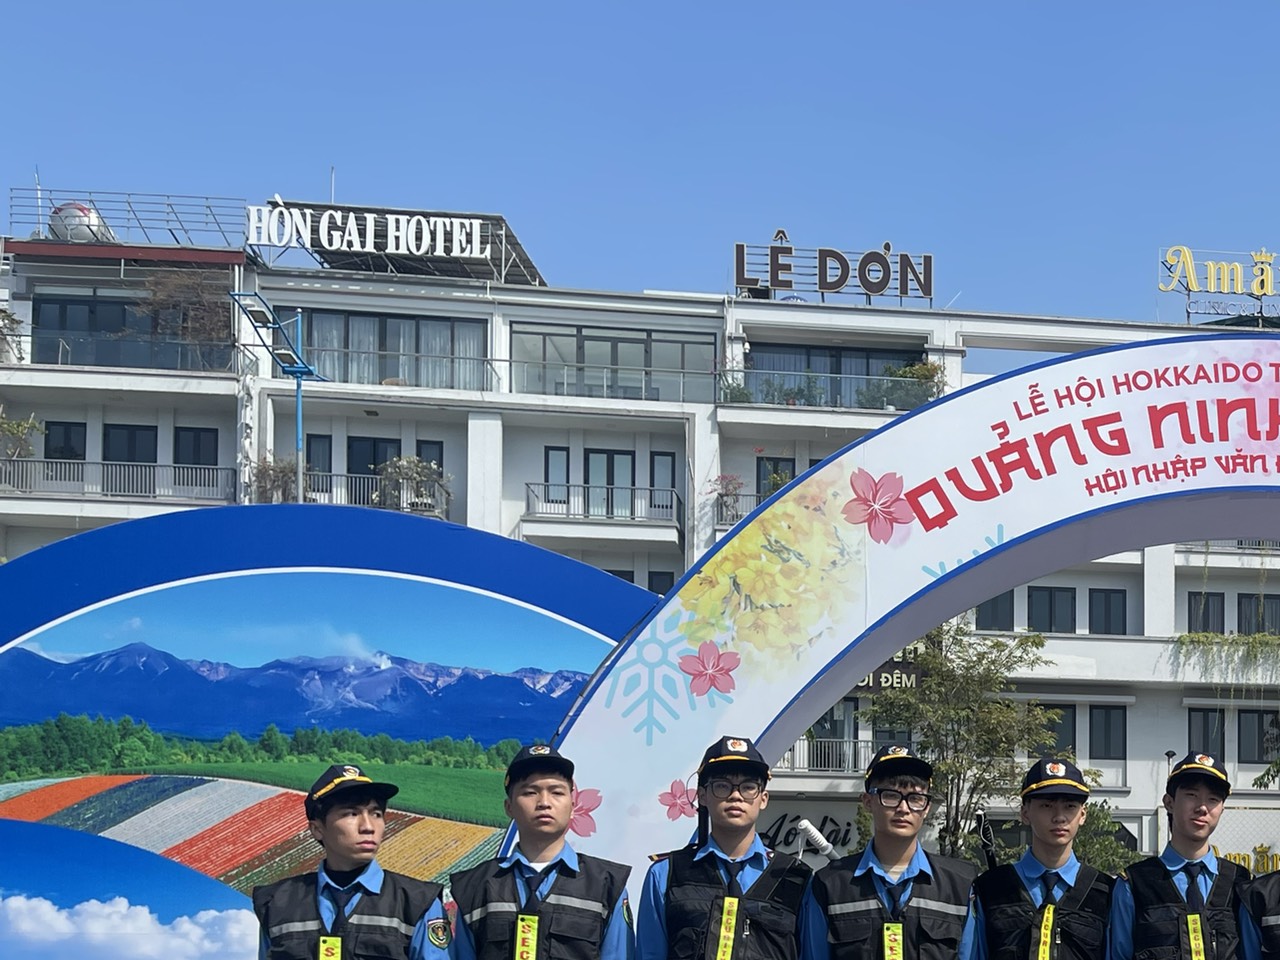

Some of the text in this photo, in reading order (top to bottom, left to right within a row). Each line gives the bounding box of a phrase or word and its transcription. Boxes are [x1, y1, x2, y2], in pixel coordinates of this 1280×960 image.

[247, 193, 492, 259] HÒN GAI HOTEL
[734, 229, 794, 289] LÊ
[1013, 382, 1050, 422] LỄ
[1054, 376, 1105, 409] HỘI
[1113, 362, 1263, 395] HOKKAIDO
[904, 411, 1132, 533] QUẢNG
